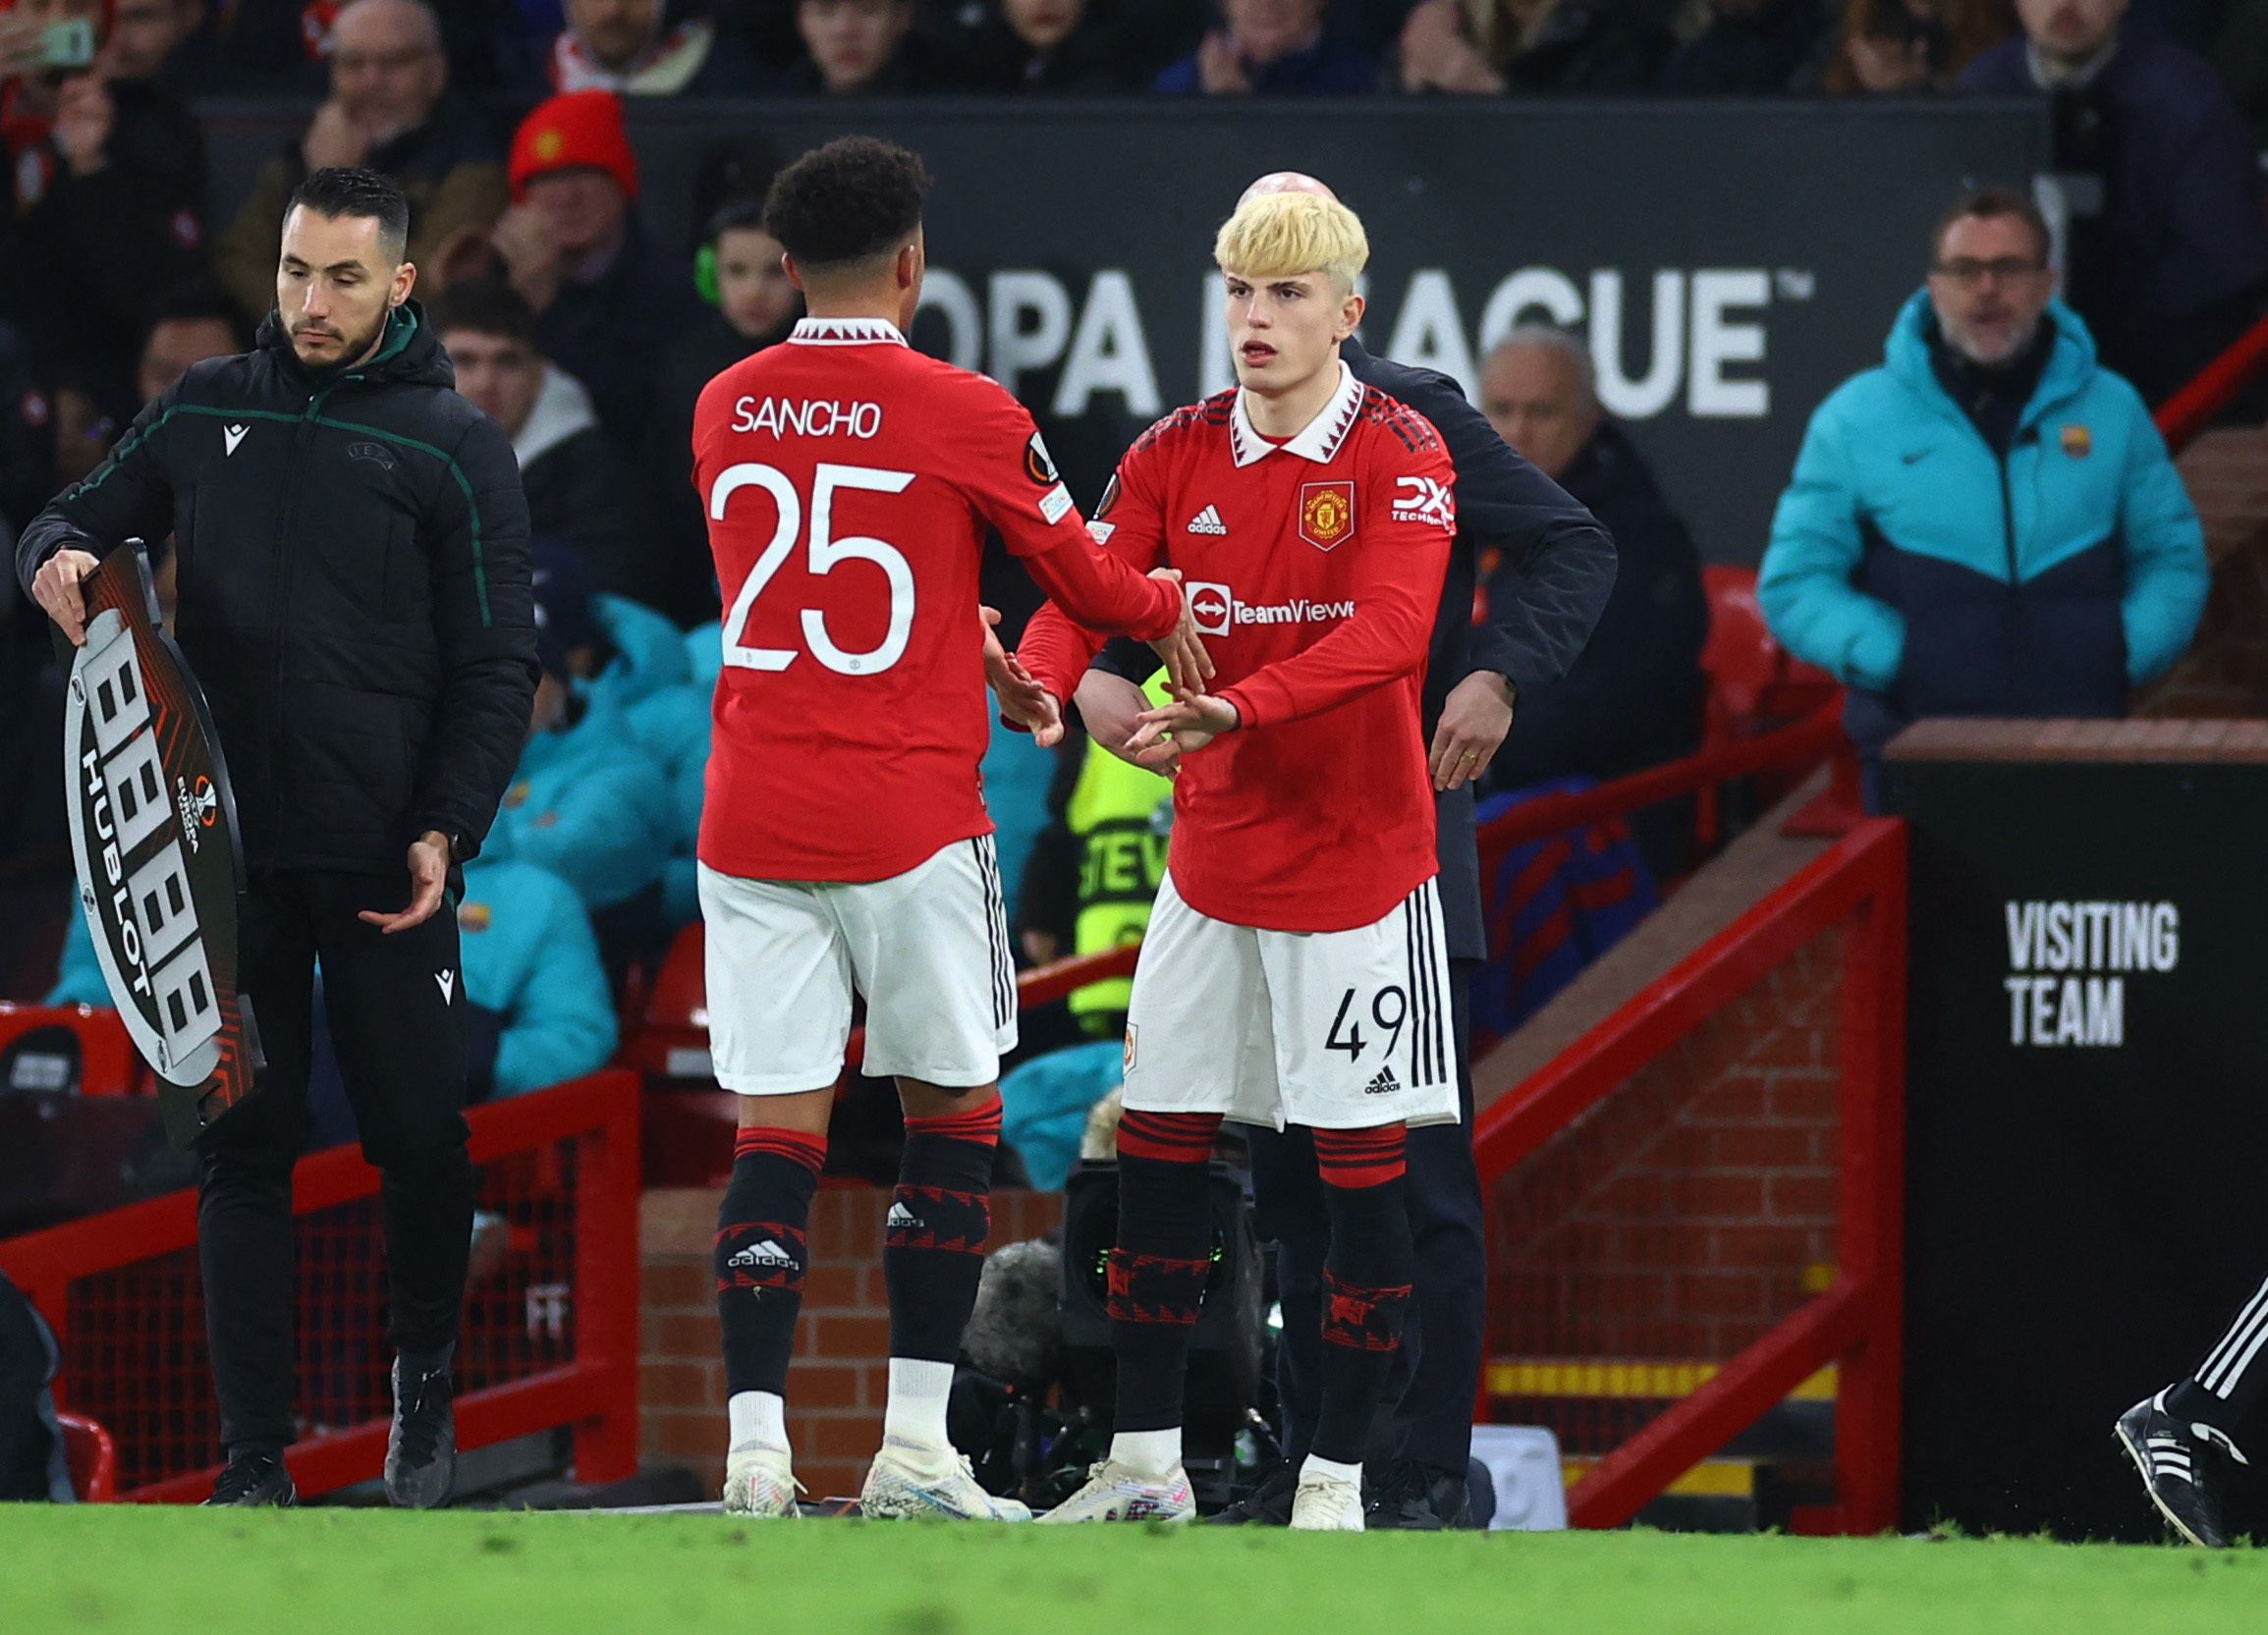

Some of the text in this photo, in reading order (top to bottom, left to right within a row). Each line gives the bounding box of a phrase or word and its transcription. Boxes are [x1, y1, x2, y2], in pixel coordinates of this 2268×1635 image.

[731, 396, 882, 441] SANCHO
[1188, 522, 1227, 535] adidas
[710, 463, 916, 676] 25
[177, 775, 199, 853] EUROPA
[82, 748, 151, 997] HUBLOT
[2005, 900, 2180, 972] VISITING
[1324, 985, 1408, 1064] 49
[2003, 975, 2126, 1048] TEAM
[1364, 1081, 1402, 1095] adidas
[727, 1255, 800, 1272] adidas
